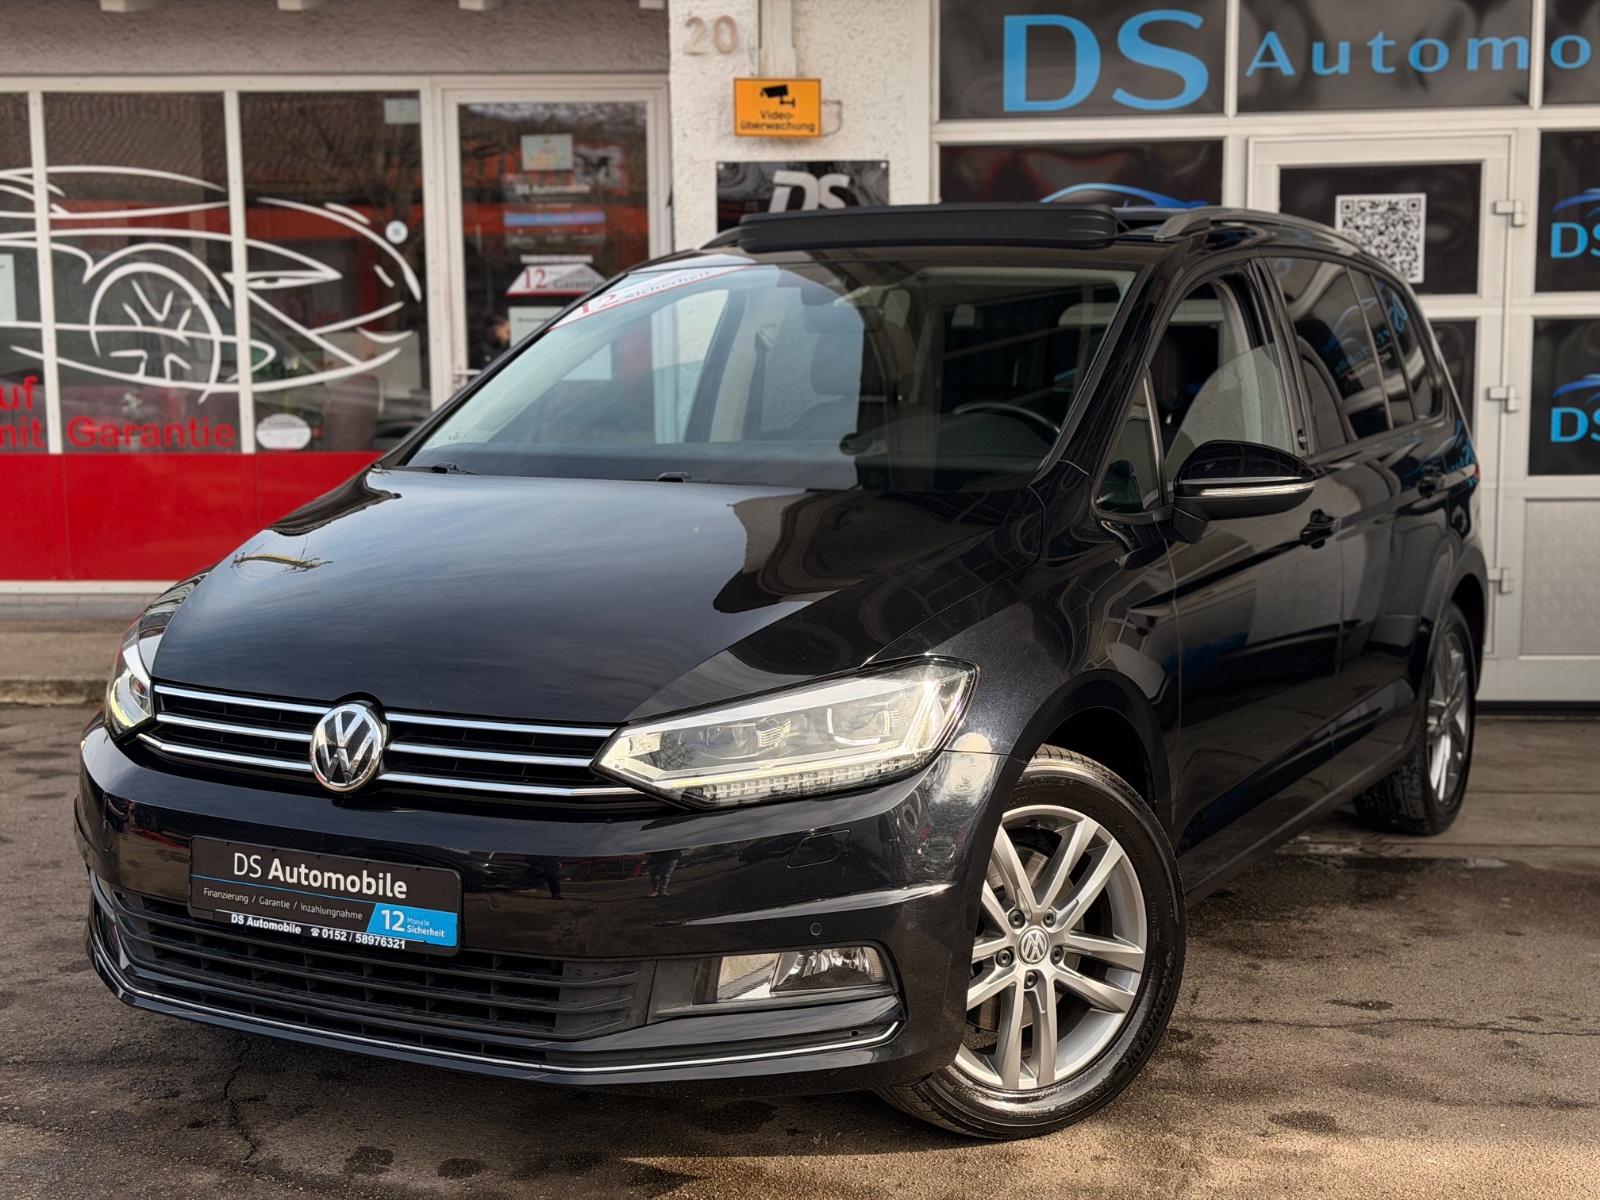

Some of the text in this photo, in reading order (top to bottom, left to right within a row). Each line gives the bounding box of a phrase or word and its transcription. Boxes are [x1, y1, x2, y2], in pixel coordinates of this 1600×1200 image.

[684, 15, 737, 55] 20
[1003, 9, 1591, 112] DS Automo
[740, 120, 816, 133] überwachung
[760, 110, 795, 120] Video-
[524, 268, 547, 289] 12
[66, 415, 236, 449] Garantie
[233, 851, 408, 899] DS Automobile
[203, 887, 249, 905] Finanzierung
[259, 895, 291, 910] Garantie
[300, 902, 363, 921] Inzahlungnahme
[381, 908, 430, 933] 12 Monate
[231, 913, 245, 925] DS
[246, 916, 302, 935] Automobile
[321, 928, 347, 942] 0152
[355, 932, 406, 950] 58976321
[406, 924, 446, 939] Sicherheit
